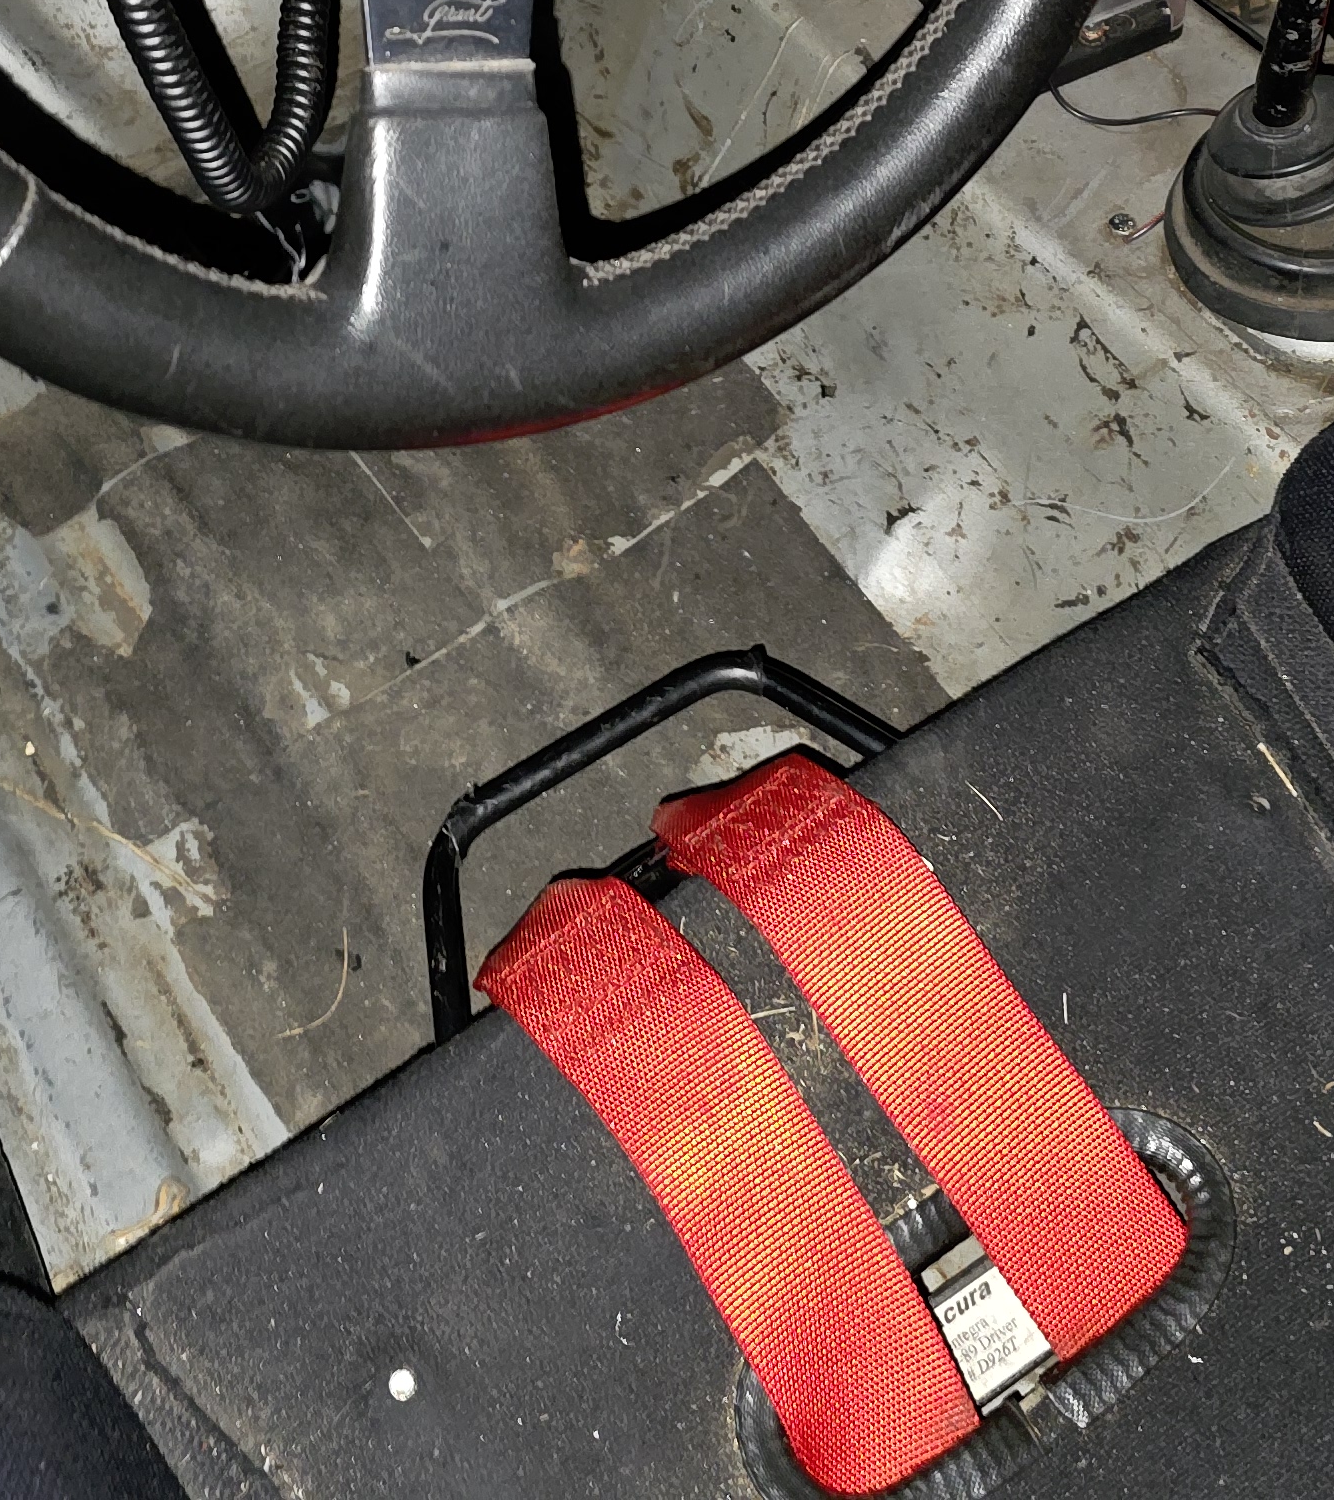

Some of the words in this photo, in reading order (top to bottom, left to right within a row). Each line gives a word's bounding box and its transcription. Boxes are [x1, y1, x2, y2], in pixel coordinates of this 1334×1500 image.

[943, 1280, 992, 1325] cura
[951, 1315, 991, 1350] ntegra
[958, 1343, 979, 1365] -89
[978, 1316, 1019, 1352] Driver
[977, 1335, 1018, 1375] D926T
